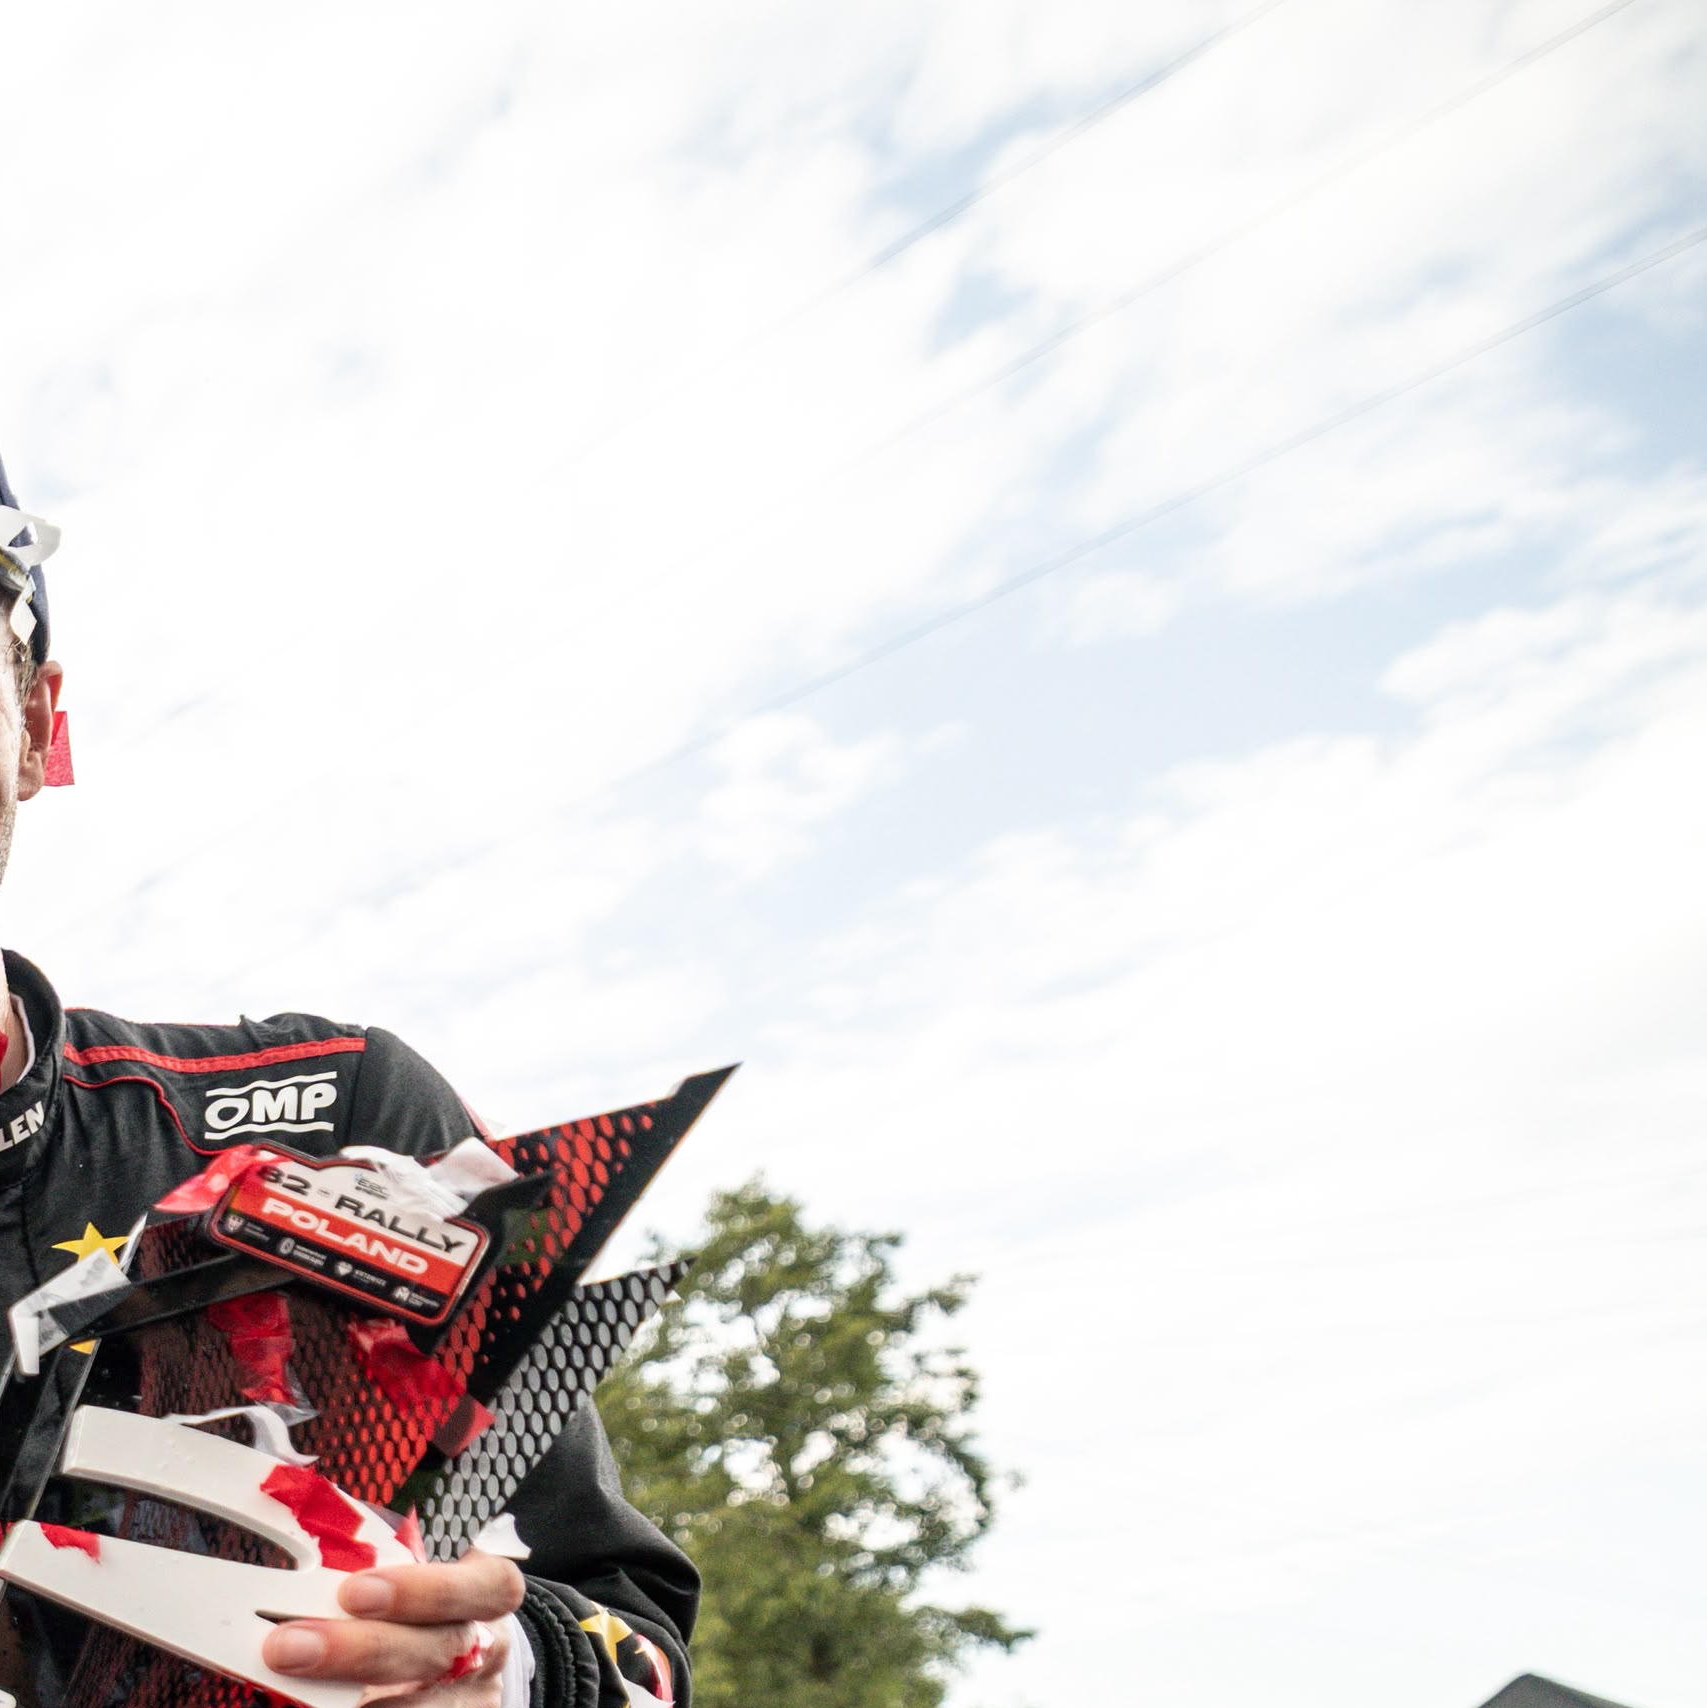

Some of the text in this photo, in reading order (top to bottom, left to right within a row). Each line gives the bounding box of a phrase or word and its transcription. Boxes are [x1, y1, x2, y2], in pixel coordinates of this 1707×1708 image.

[205, 1082, 337, 1131] OMP
[261, 1196, 429, 1275] POLAND
[334, 1193, 466, 1255] RALLY
